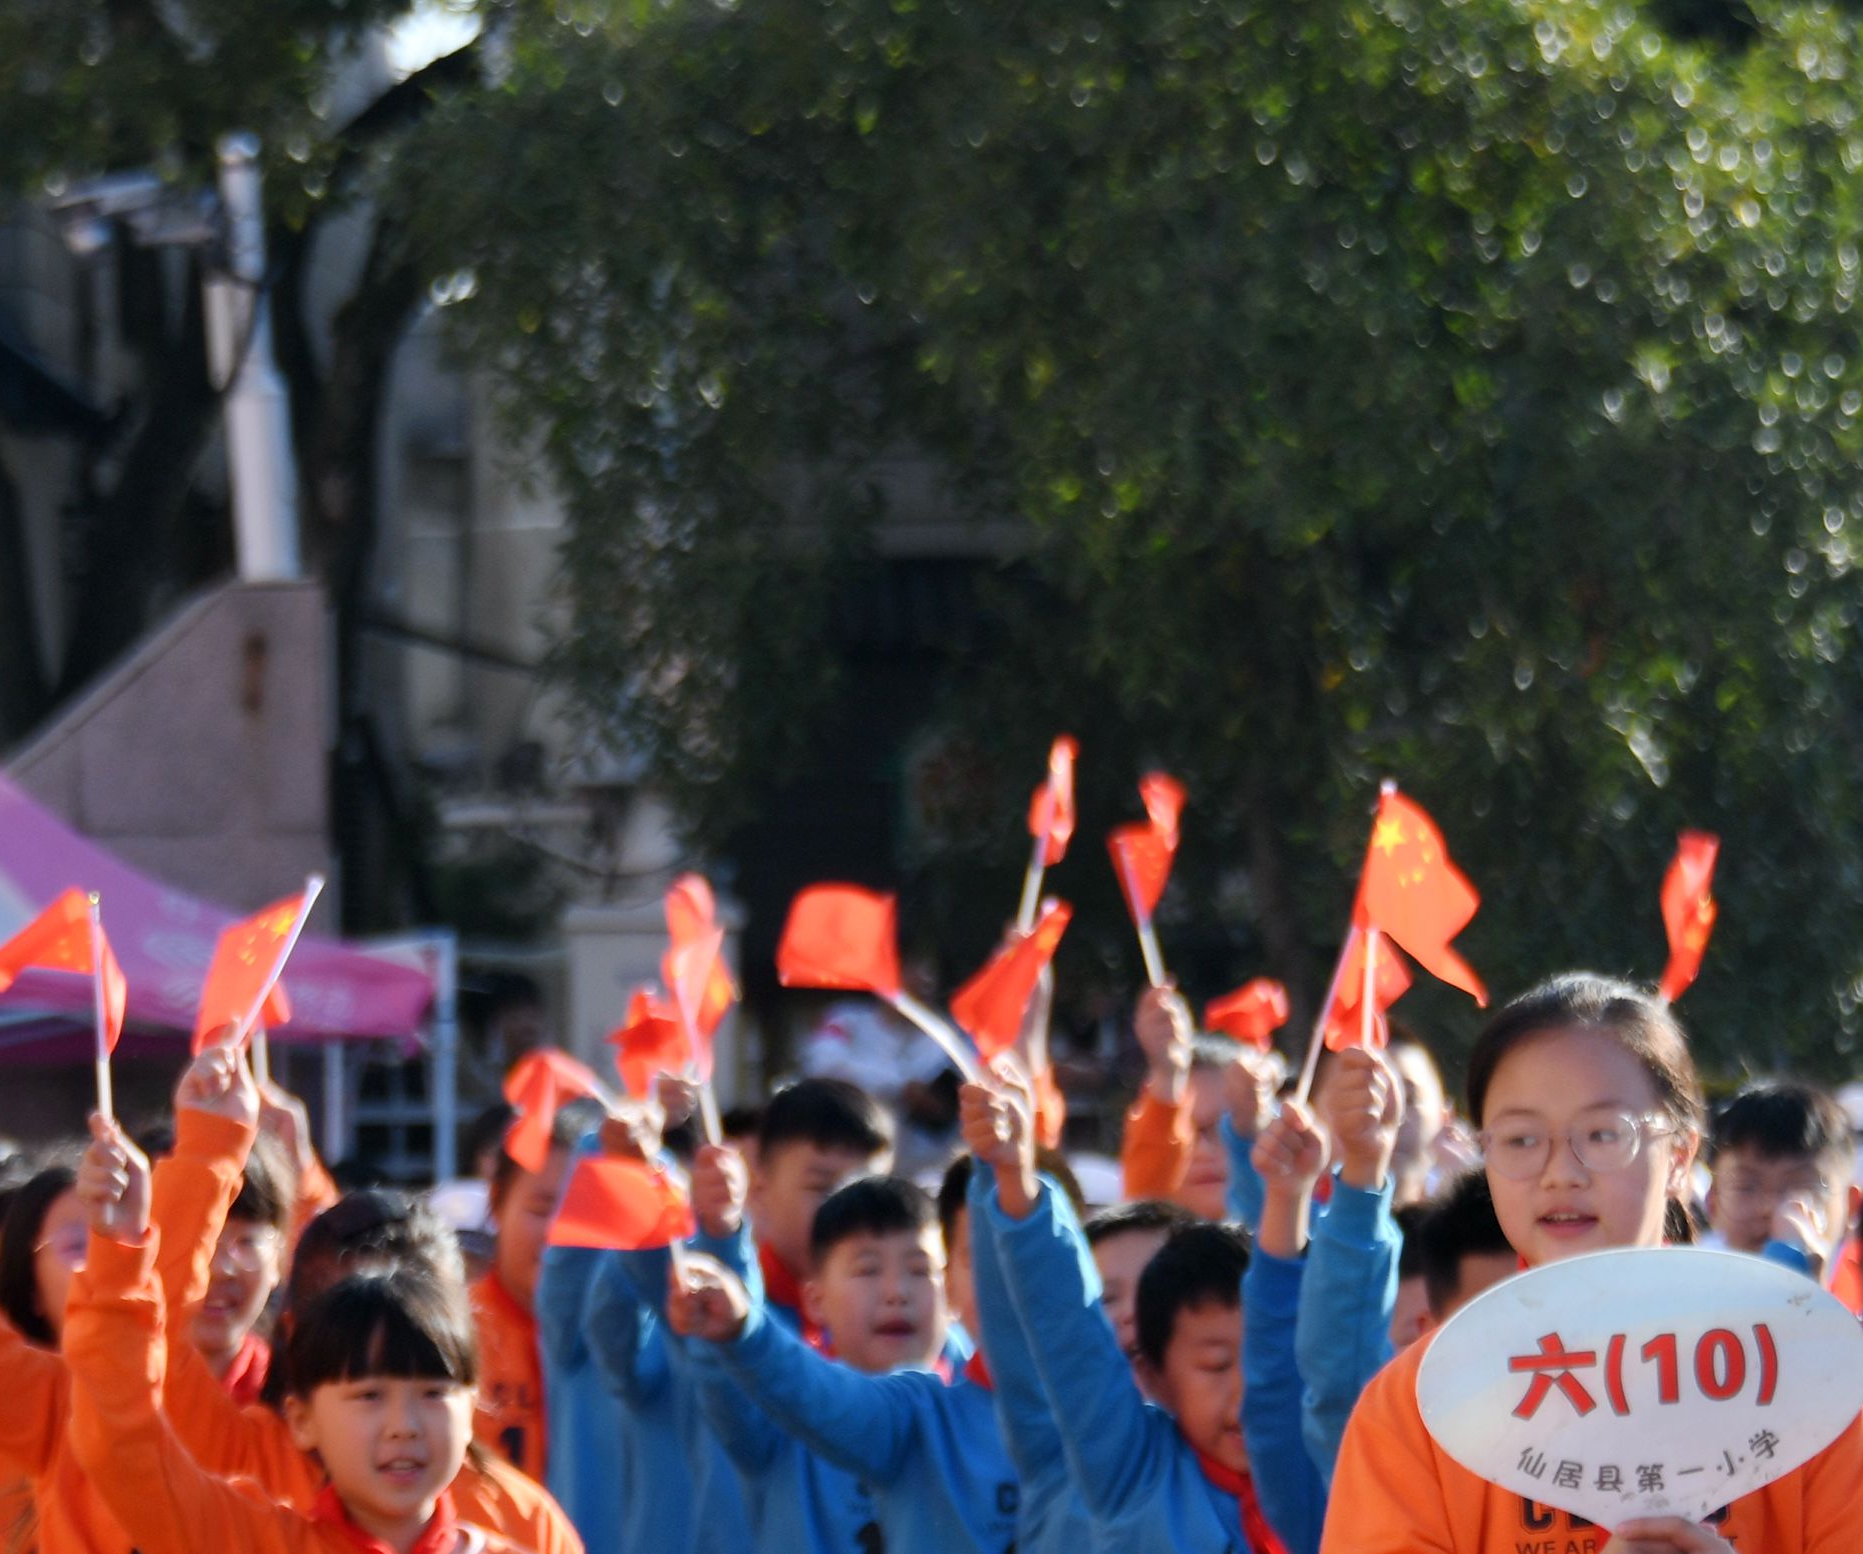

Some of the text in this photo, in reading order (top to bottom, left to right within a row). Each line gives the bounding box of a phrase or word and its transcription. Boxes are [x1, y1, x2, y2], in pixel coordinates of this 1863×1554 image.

[1508, 1323, 1778, 1420] 六(10)
[1516, 1429, 1780, 1493] 仙居县第一小学
